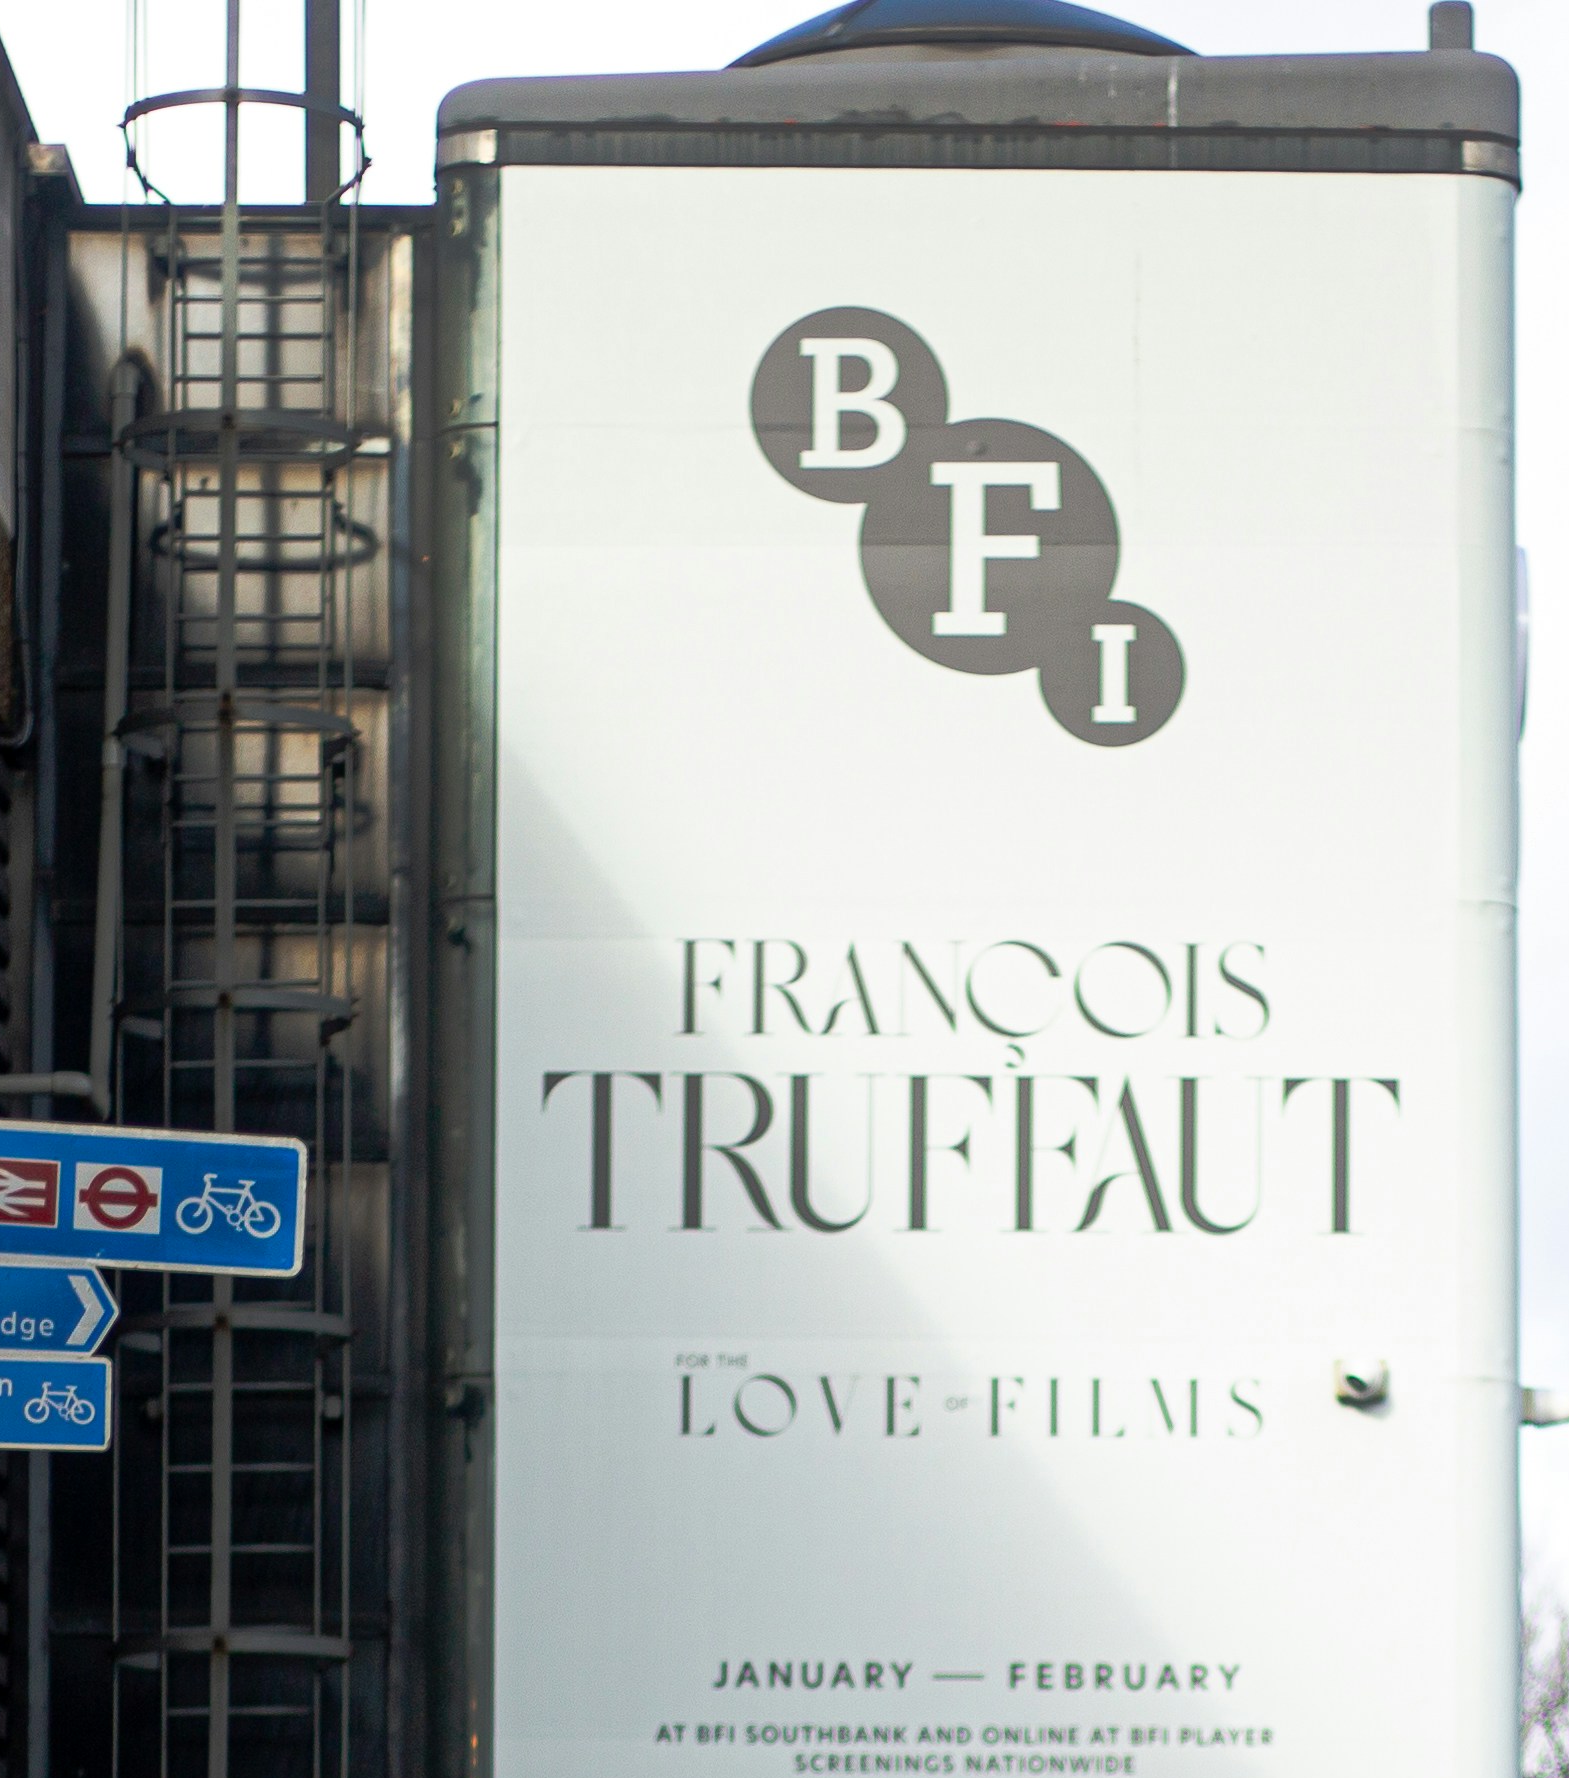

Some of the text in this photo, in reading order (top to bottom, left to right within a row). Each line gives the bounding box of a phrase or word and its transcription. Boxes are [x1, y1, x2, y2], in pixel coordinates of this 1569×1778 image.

[799, 337, 1137, 723] BFI
[675, 938, 1271, 1069] FRANÇOIS
[541, 1069, 1402, 1236] TRUFFAUT
[677, 1373, 922, 1437] LOVE
[988, 1376, 1266, 1439] FILMS
[713, 1661, 914, 1690] JANUARY
[1008, 1662, 1242, 1691] FEBRUARY
[655, 1724, 1275, 1747] AT BFI SOUTHBANK AND ONLINE AT BFI PLAYER
[794, 1752, 1137, 1775] SCREENINGS NATIONWIDE
